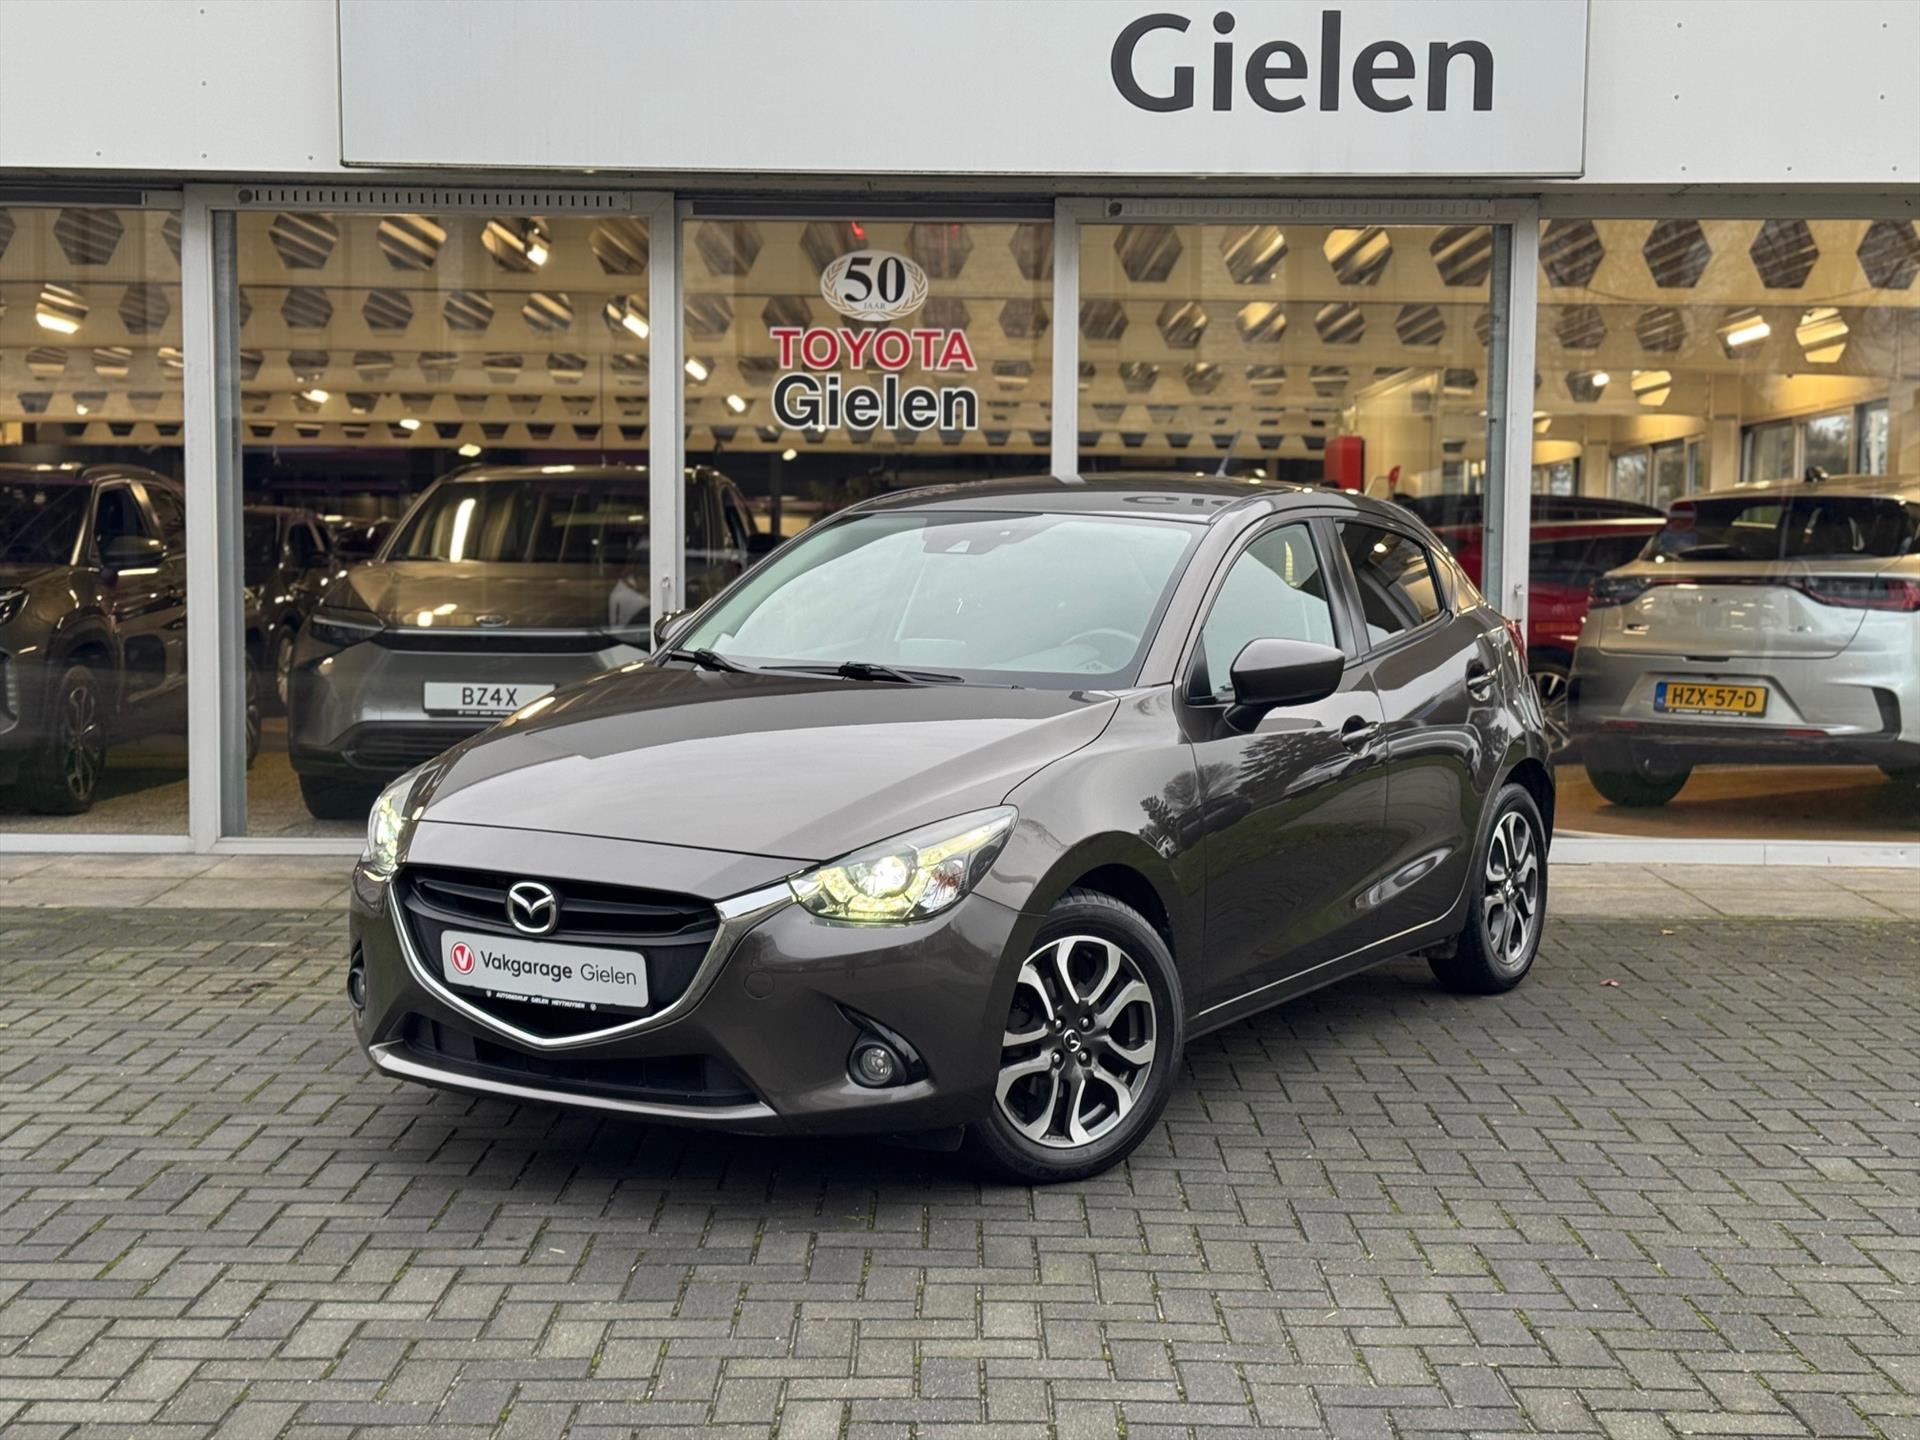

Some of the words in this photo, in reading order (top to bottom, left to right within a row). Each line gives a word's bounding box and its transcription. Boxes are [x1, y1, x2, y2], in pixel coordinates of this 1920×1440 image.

[1110, 10, 1494, 113] Gielen
[844, 256, 906, 303] 50
[863, 302, 886, 310] JAAR
[770, 328, 977, 370] TOYOTA
[773, 373, 978, 430] Gielen
[462, 687, 517, 706] BZ4X
[1672, 687, 1757, 708] HZX-57-D
[480, 950, 573, 982] Vakgarage
[580, 963, 637, 985] Gielen
